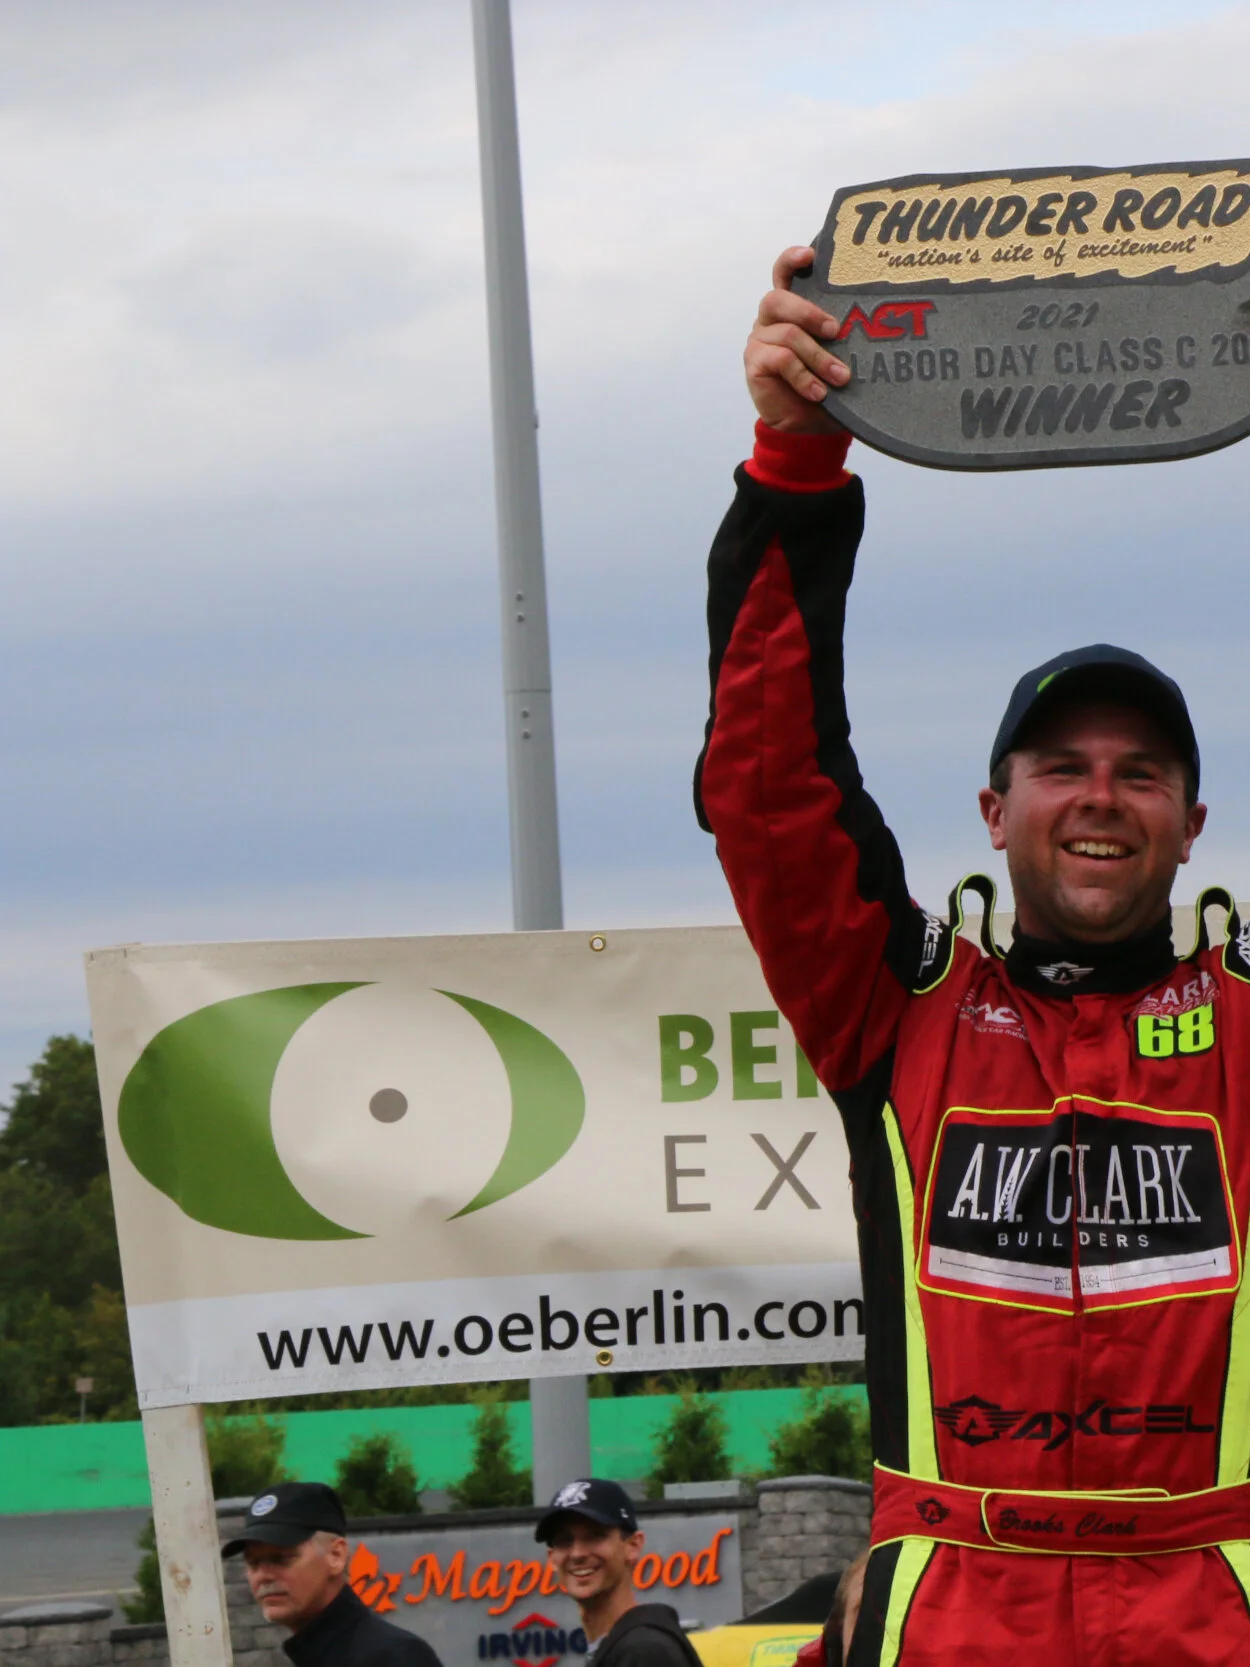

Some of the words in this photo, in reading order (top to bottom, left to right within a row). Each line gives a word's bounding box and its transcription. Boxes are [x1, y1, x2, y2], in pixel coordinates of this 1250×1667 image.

[852, 190, 1098, 246] THUNDER
[991, 243, 1034, 263] site
[1043, 238, 1067, 267] of
[836, 300, 937, 341] ACT
[1016, 301, 1100, 330] 2021
[850, 348, 960, 384] LABOR
[974, 344, 1037, 378] DAY
[1053, 336, 1164, 375] CLASS
[1175, 335, 1197, 370] C
[960, 377, 1191, 440] WINNER
[1136, 1002, 1216, 1059] 68
[1045, 1143, 1202, 1226] CLARK
[997, 1231, 1150, 1248] BUILDERS
[1010, 1400, 1216, 1452] AXCEL
[478, 1627, 589, 1660] IRVING
